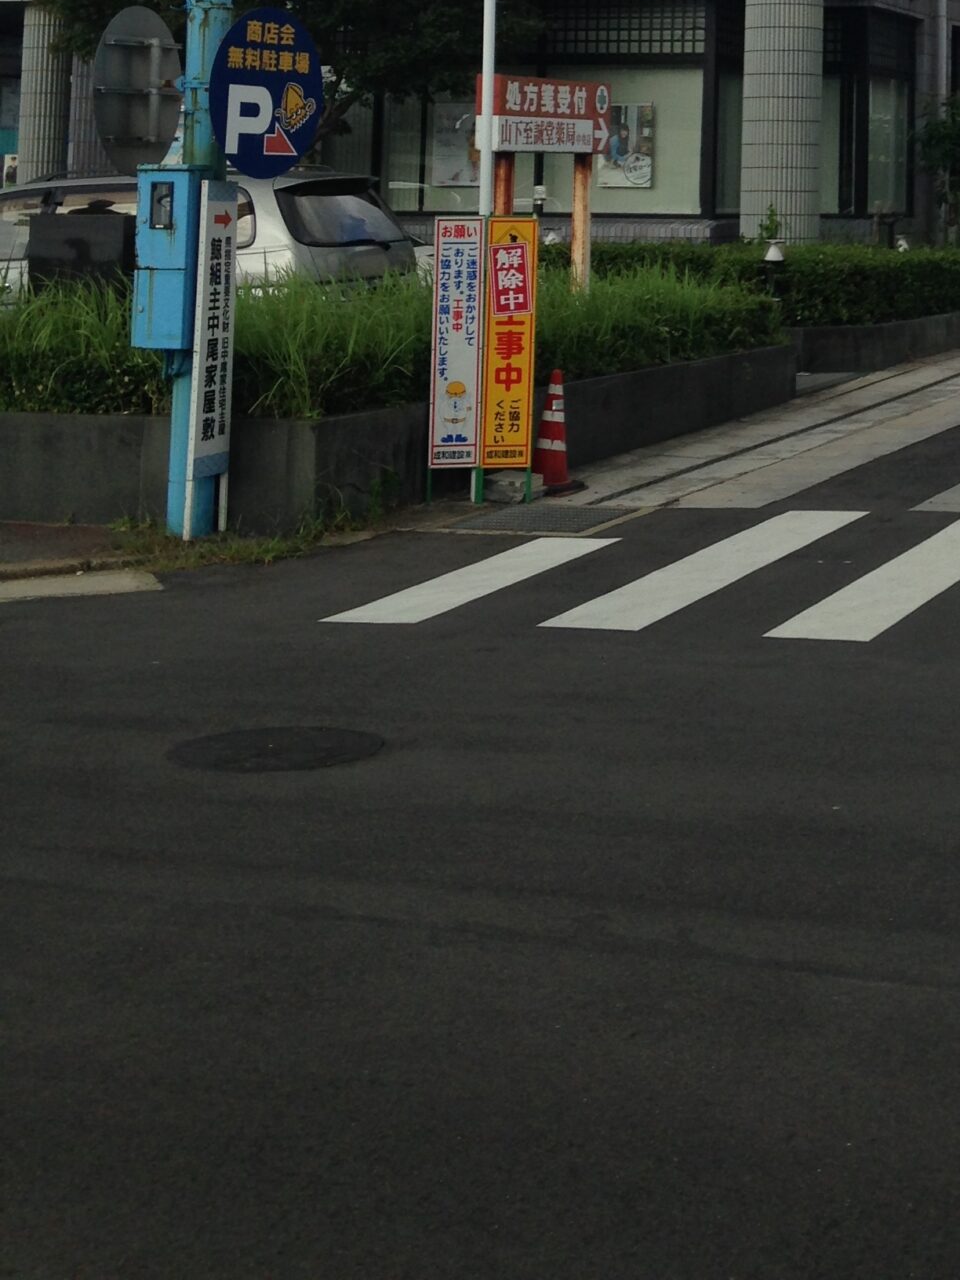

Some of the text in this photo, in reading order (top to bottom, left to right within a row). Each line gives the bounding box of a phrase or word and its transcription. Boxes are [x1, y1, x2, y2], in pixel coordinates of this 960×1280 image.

[246, 20, 296, 46] 商店会
[227, 46, 310, 74] 無料駐車場
[506, 81, 588, 114] 処方箋受付
[225, 84, 273, 154] P
[441, 225, 478, 239] お願い
[464, 247, 478, 347] ご迷惑をおかけして
[495, 248, 525, 311] 解除中
[438, 247, 452, 381] ご協力をお願いいたします。
[493, 399, 506, 444] ください
[507, 399, 522, 433] ご協力
